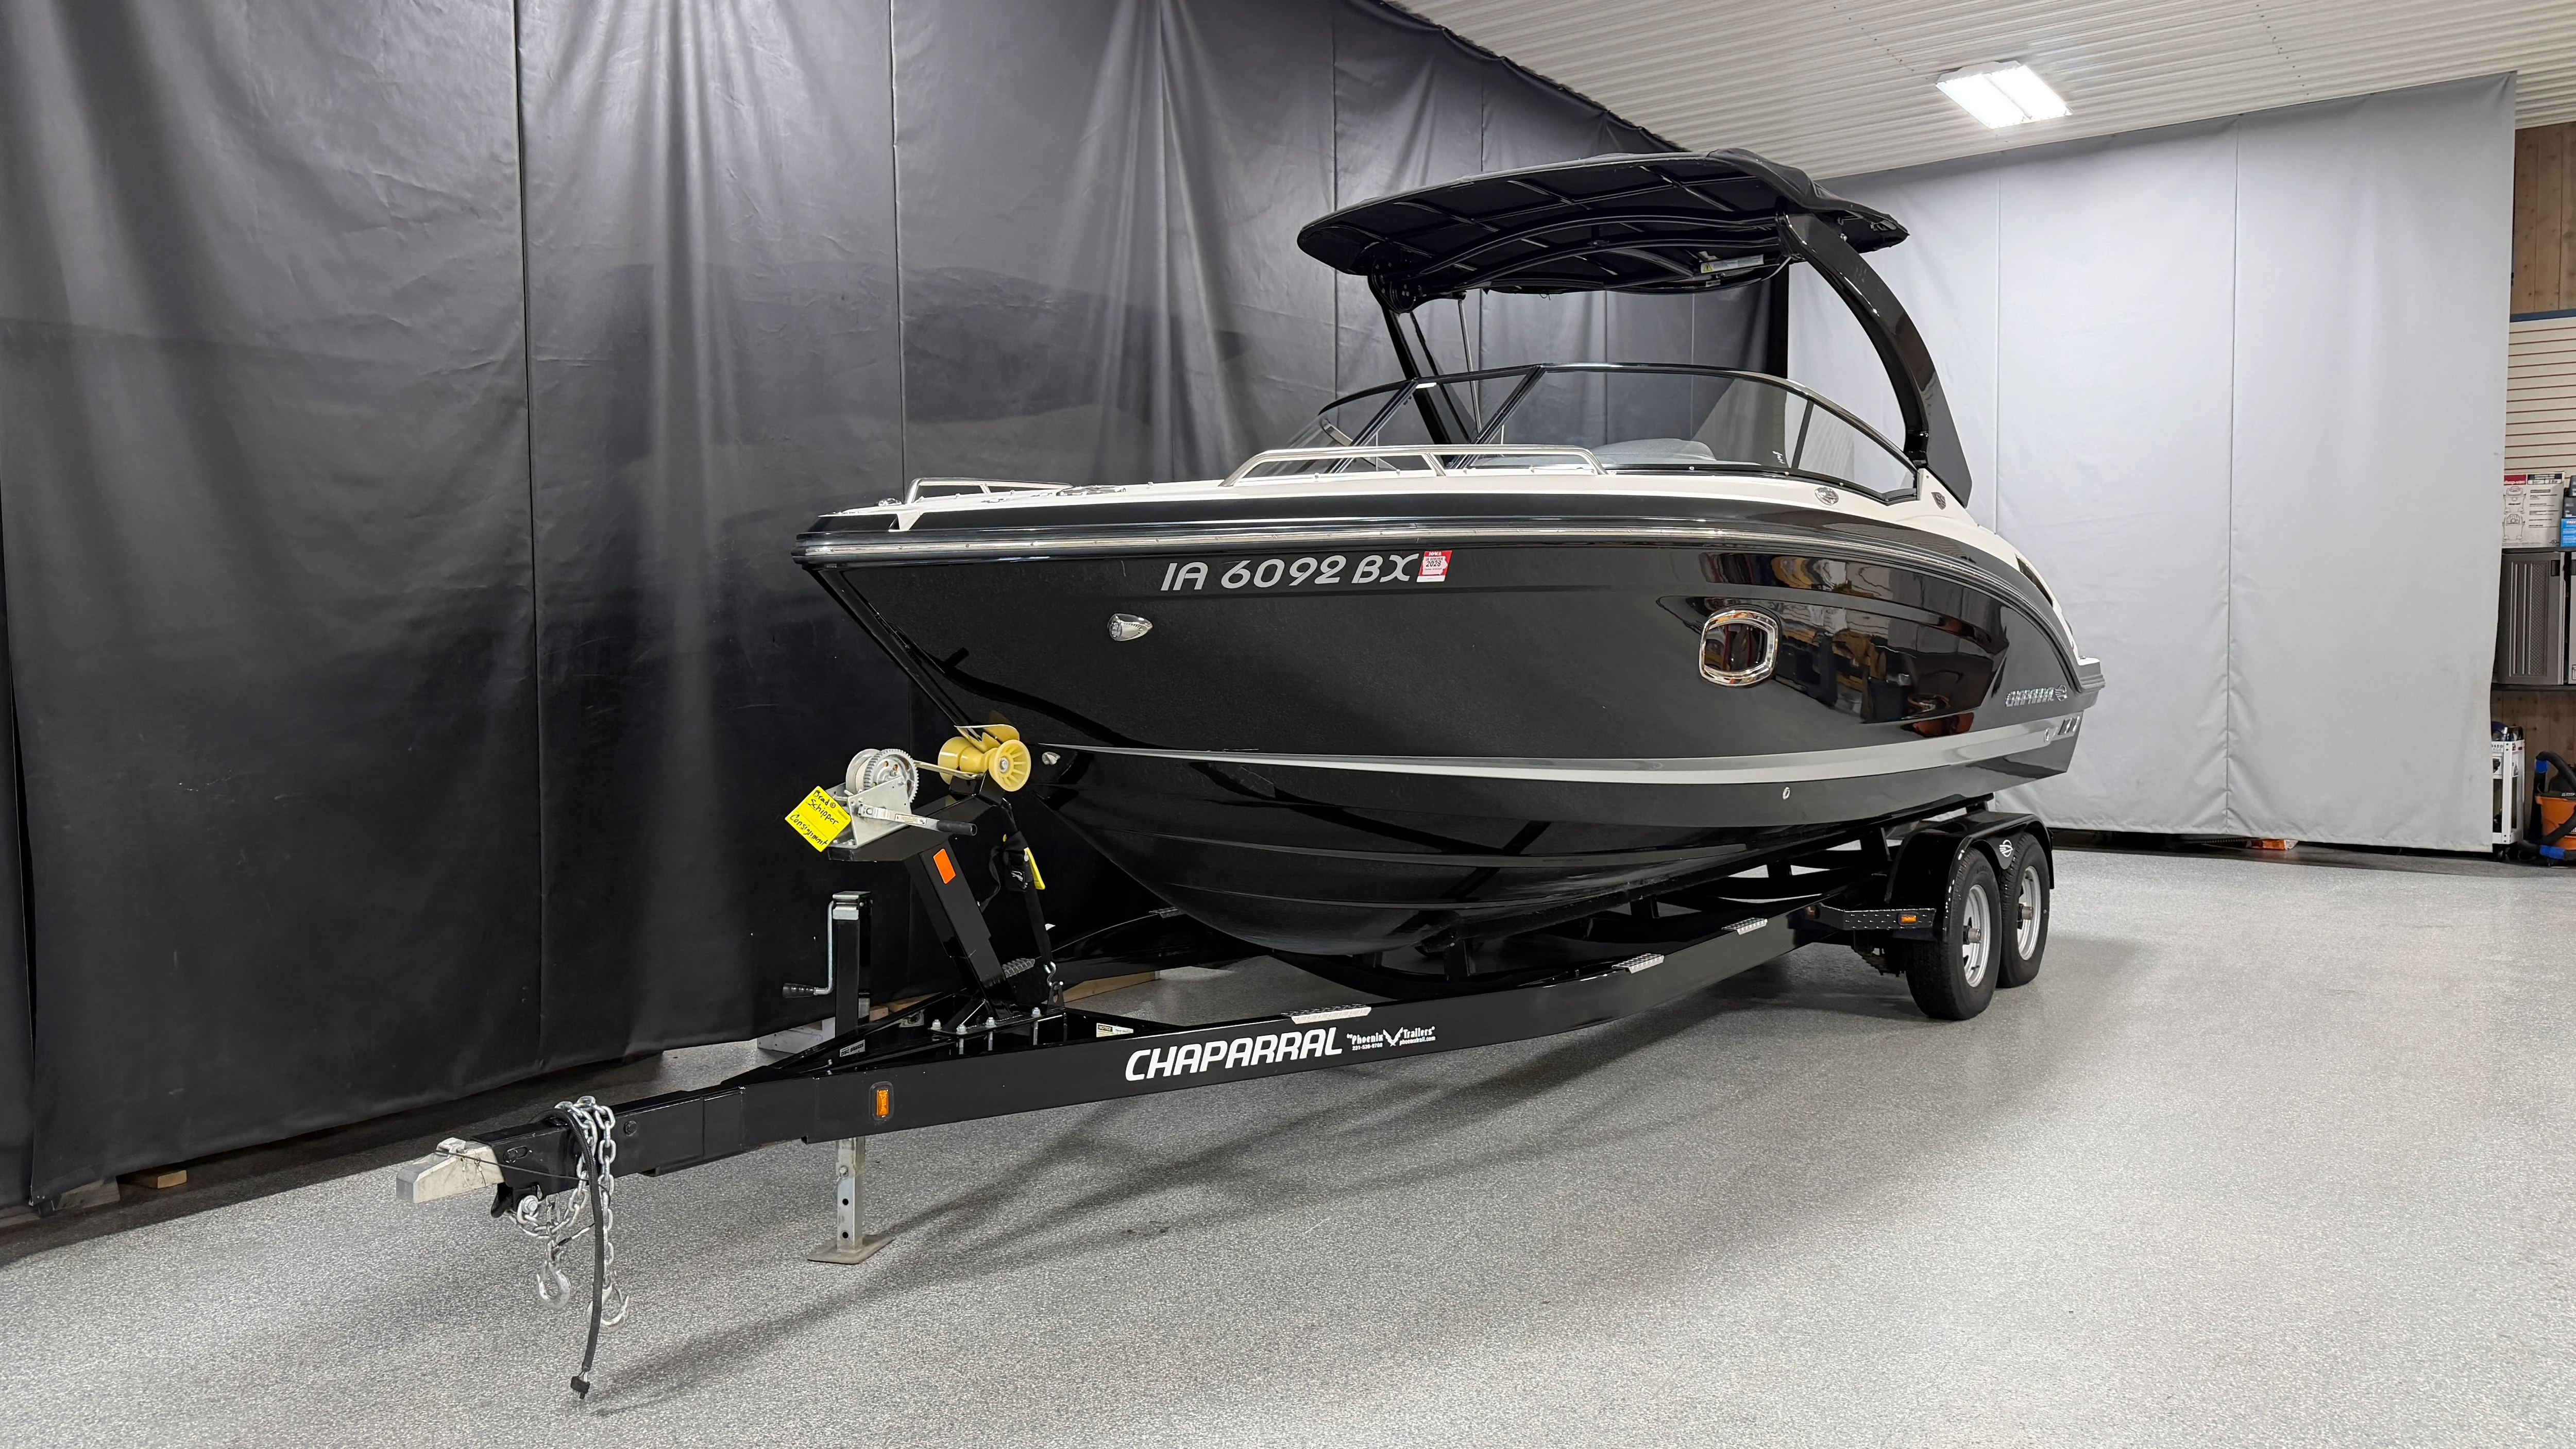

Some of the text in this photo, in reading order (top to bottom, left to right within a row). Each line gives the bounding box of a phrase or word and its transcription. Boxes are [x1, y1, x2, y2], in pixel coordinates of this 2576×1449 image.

[1160, 553, 1419, 591] IA 6092 BX
[812, 790, 830, 806] Brad
[1351, 1032, 1384, 1045] Phoenix
[1125, 1027, 1343, 1081] CHAPARRAL
